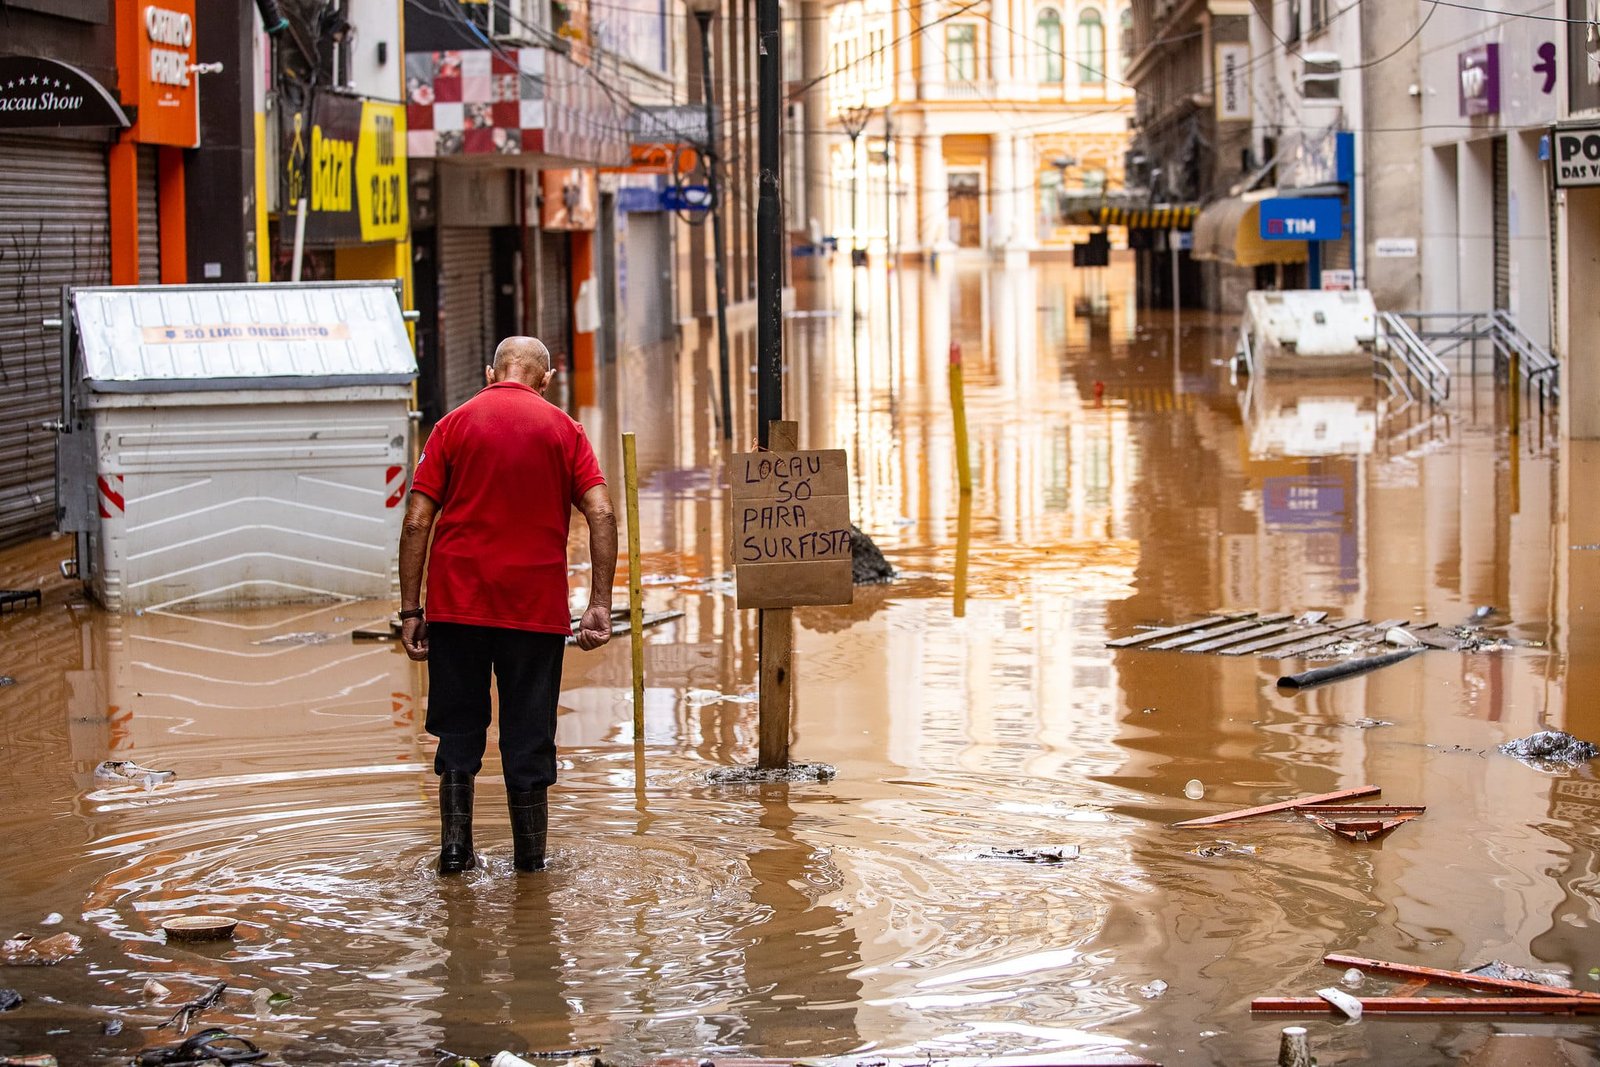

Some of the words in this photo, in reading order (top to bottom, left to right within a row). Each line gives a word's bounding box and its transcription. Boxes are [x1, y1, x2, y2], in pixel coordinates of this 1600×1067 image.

[146, 5, 192, 48] ORTHO
[151, 48, 190, 87] PRIDE
[39, 92, 83, 111] Show
[312, 124, 354, 212] Bazar
[1561, 165, 1587, 178] DAS
[1285, 218, 1316, 234] TIM
[745, 456, 820, 483] LOCAU
[776, 478, 812, 503] SÓ
[743, 505, 806, 533] PARA
